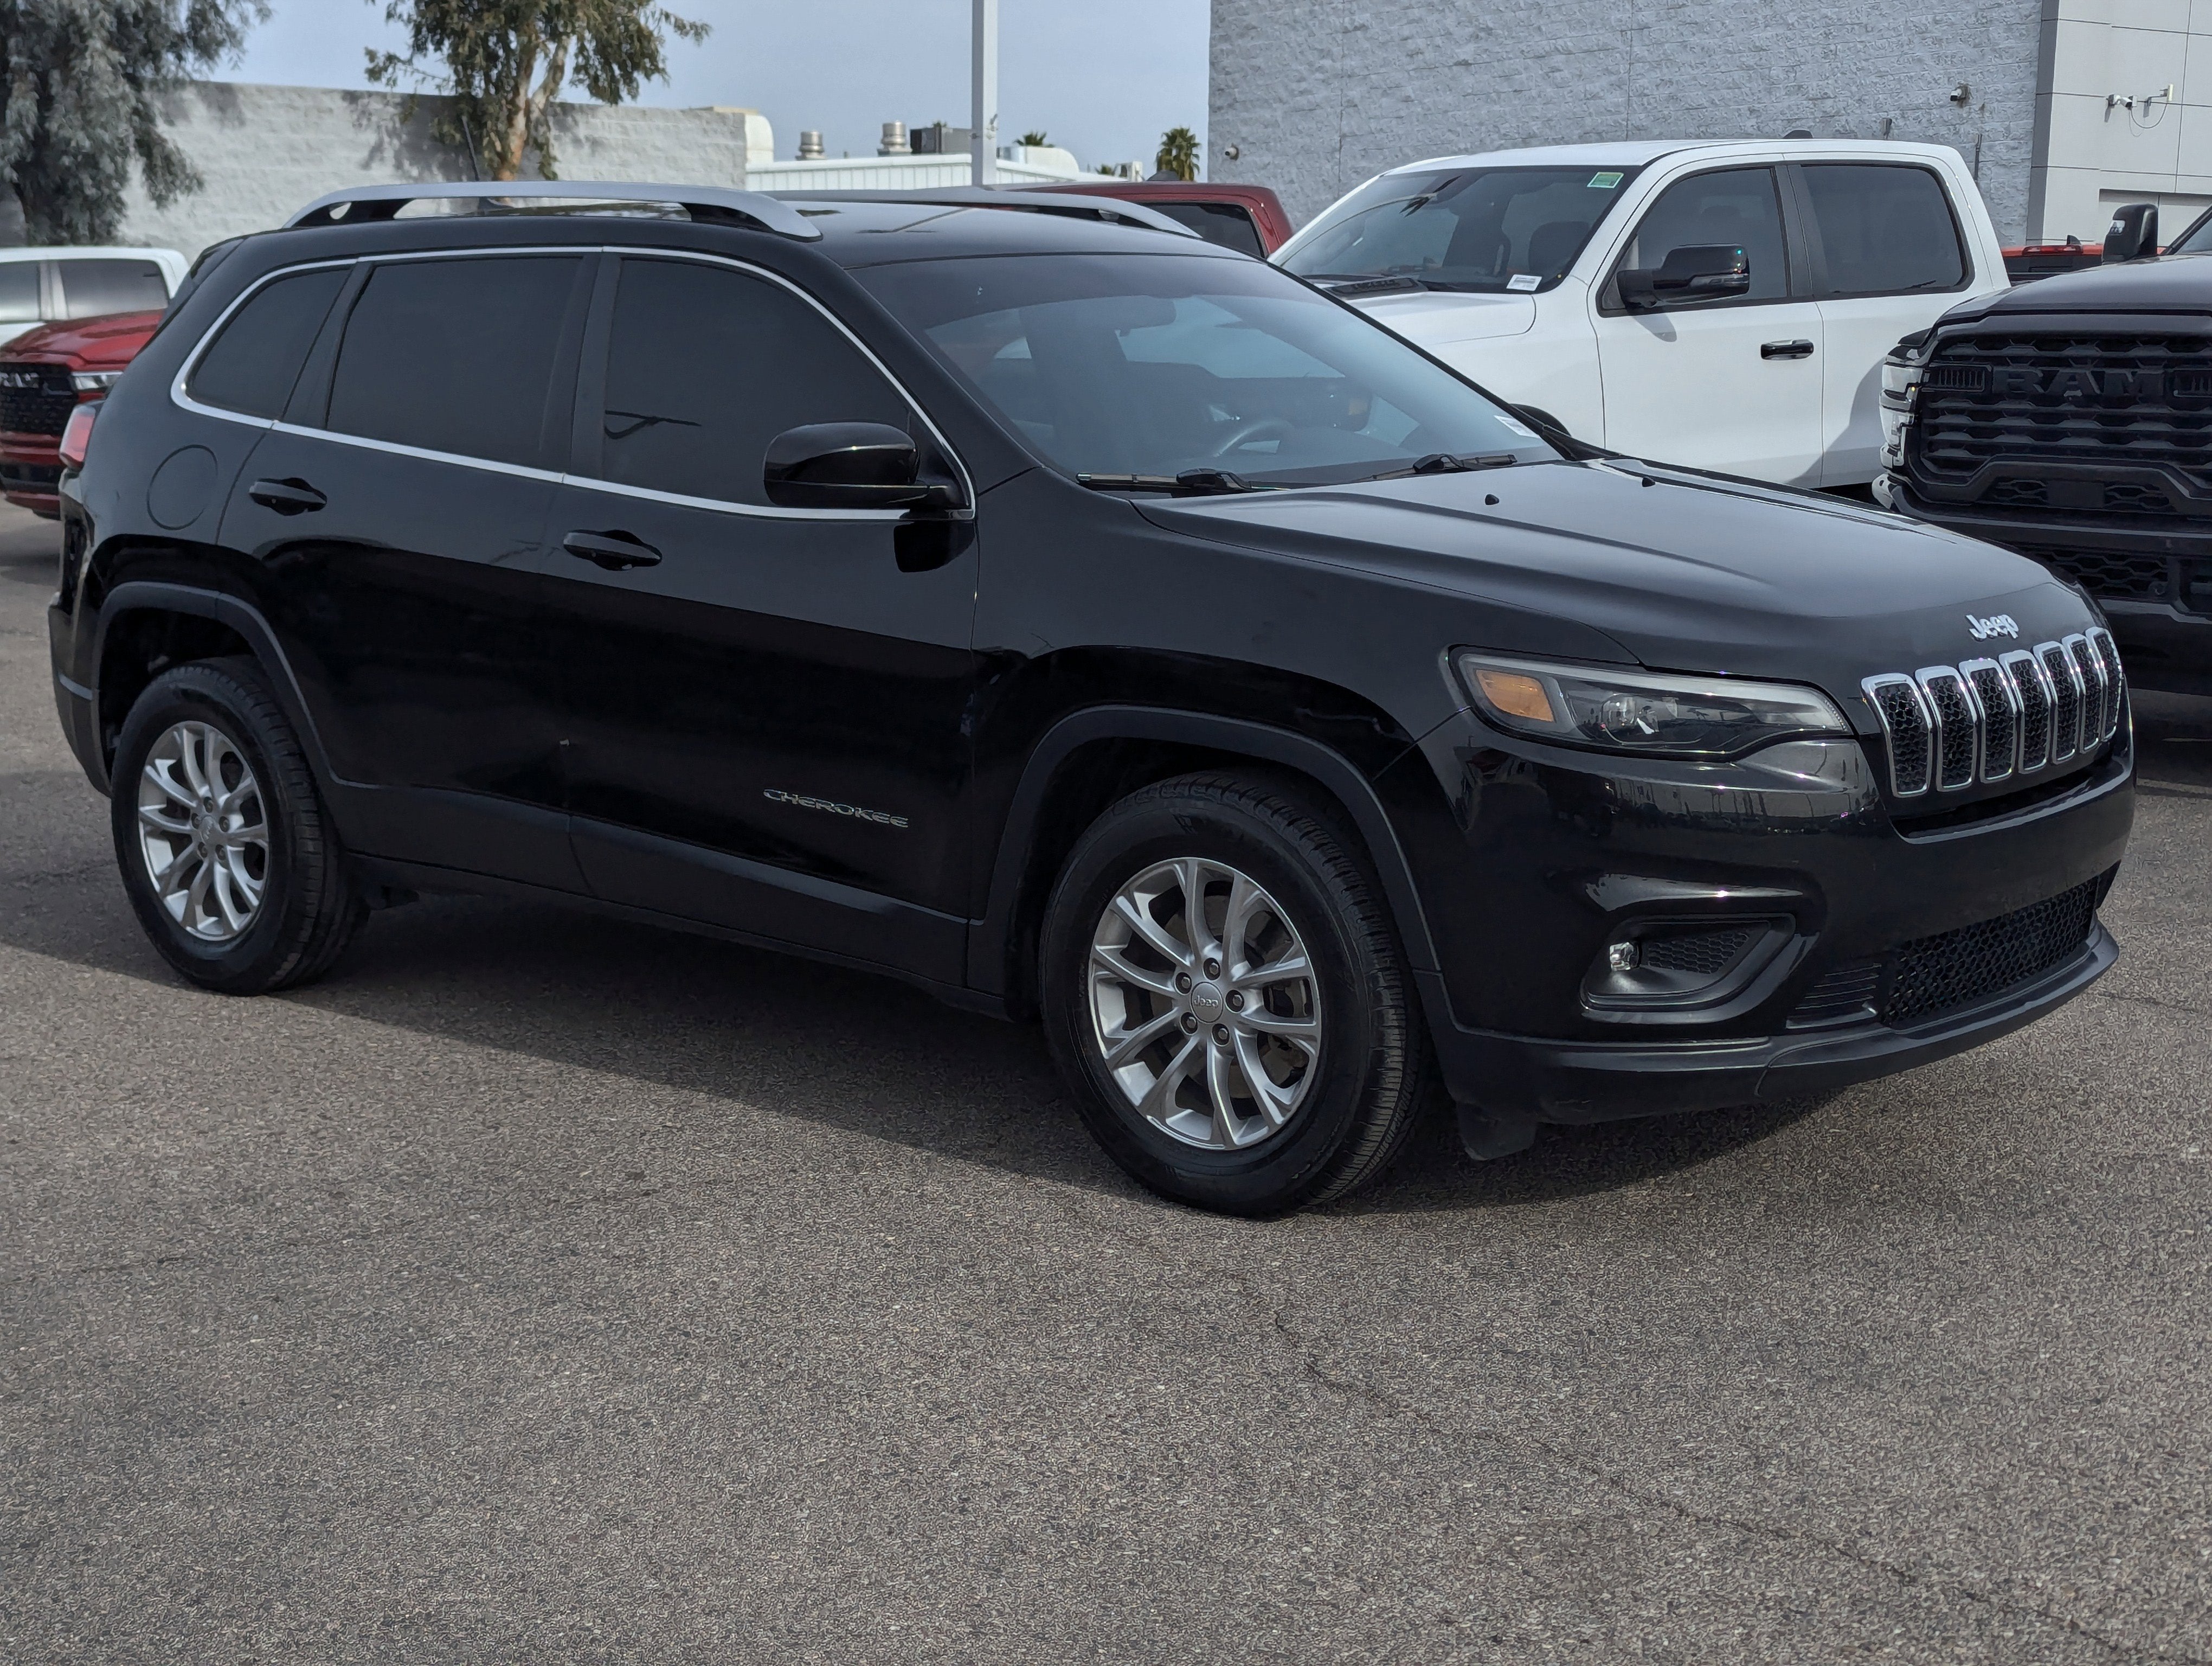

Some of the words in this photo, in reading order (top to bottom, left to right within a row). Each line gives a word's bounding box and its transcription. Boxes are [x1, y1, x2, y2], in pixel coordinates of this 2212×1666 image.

[1992, 366, 2164, 396] RAM
[1965, 614, 2019, 639] Jeep
[763, 789, 909, 828] CHEROKEE
[1194, 995, 1219, 1008] Jeep
